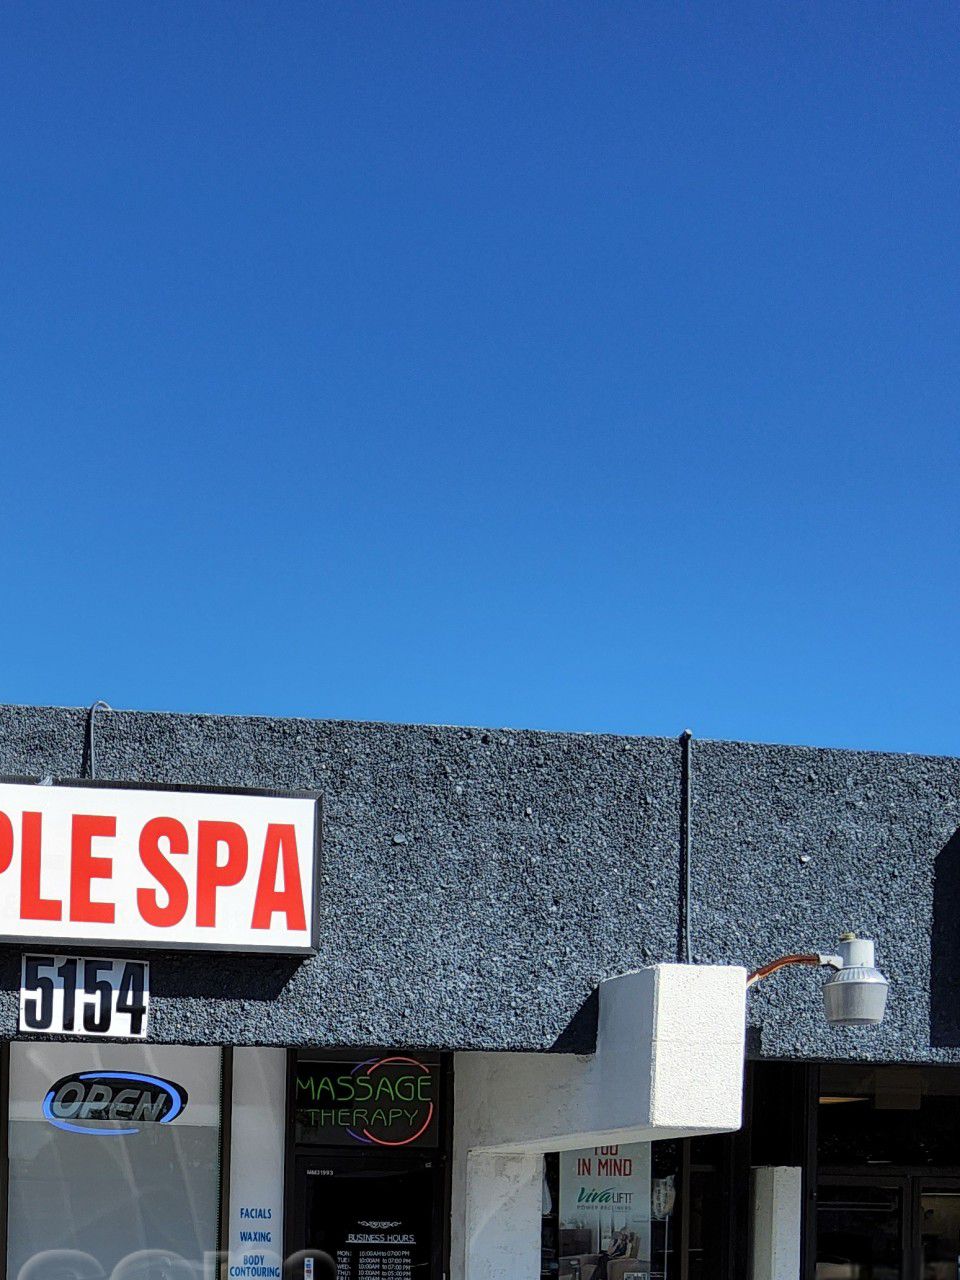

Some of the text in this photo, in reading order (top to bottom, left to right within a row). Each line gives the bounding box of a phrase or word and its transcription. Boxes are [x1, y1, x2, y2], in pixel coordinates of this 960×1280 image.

[136, 816, 307, 932] SPA
[24, 956, 147, 1034] 5154
[296, 1075, 432, 1101] MASSAGE
[52, 1081, 167, 1121] OPEN
[305, 1108, 419, 1127] THERAPY
[577, 1158, 632, 1177] IN MIND
[240, 1208, 272, 1219] FACIALS
[240, 1231, 272, 1243] WAXING
[348, 1234, 415, 1243] BUSINESS HOURS
[243, 1255, 265, 1266] BODY
[229, 1266, 280, 1278] CONTOURING
